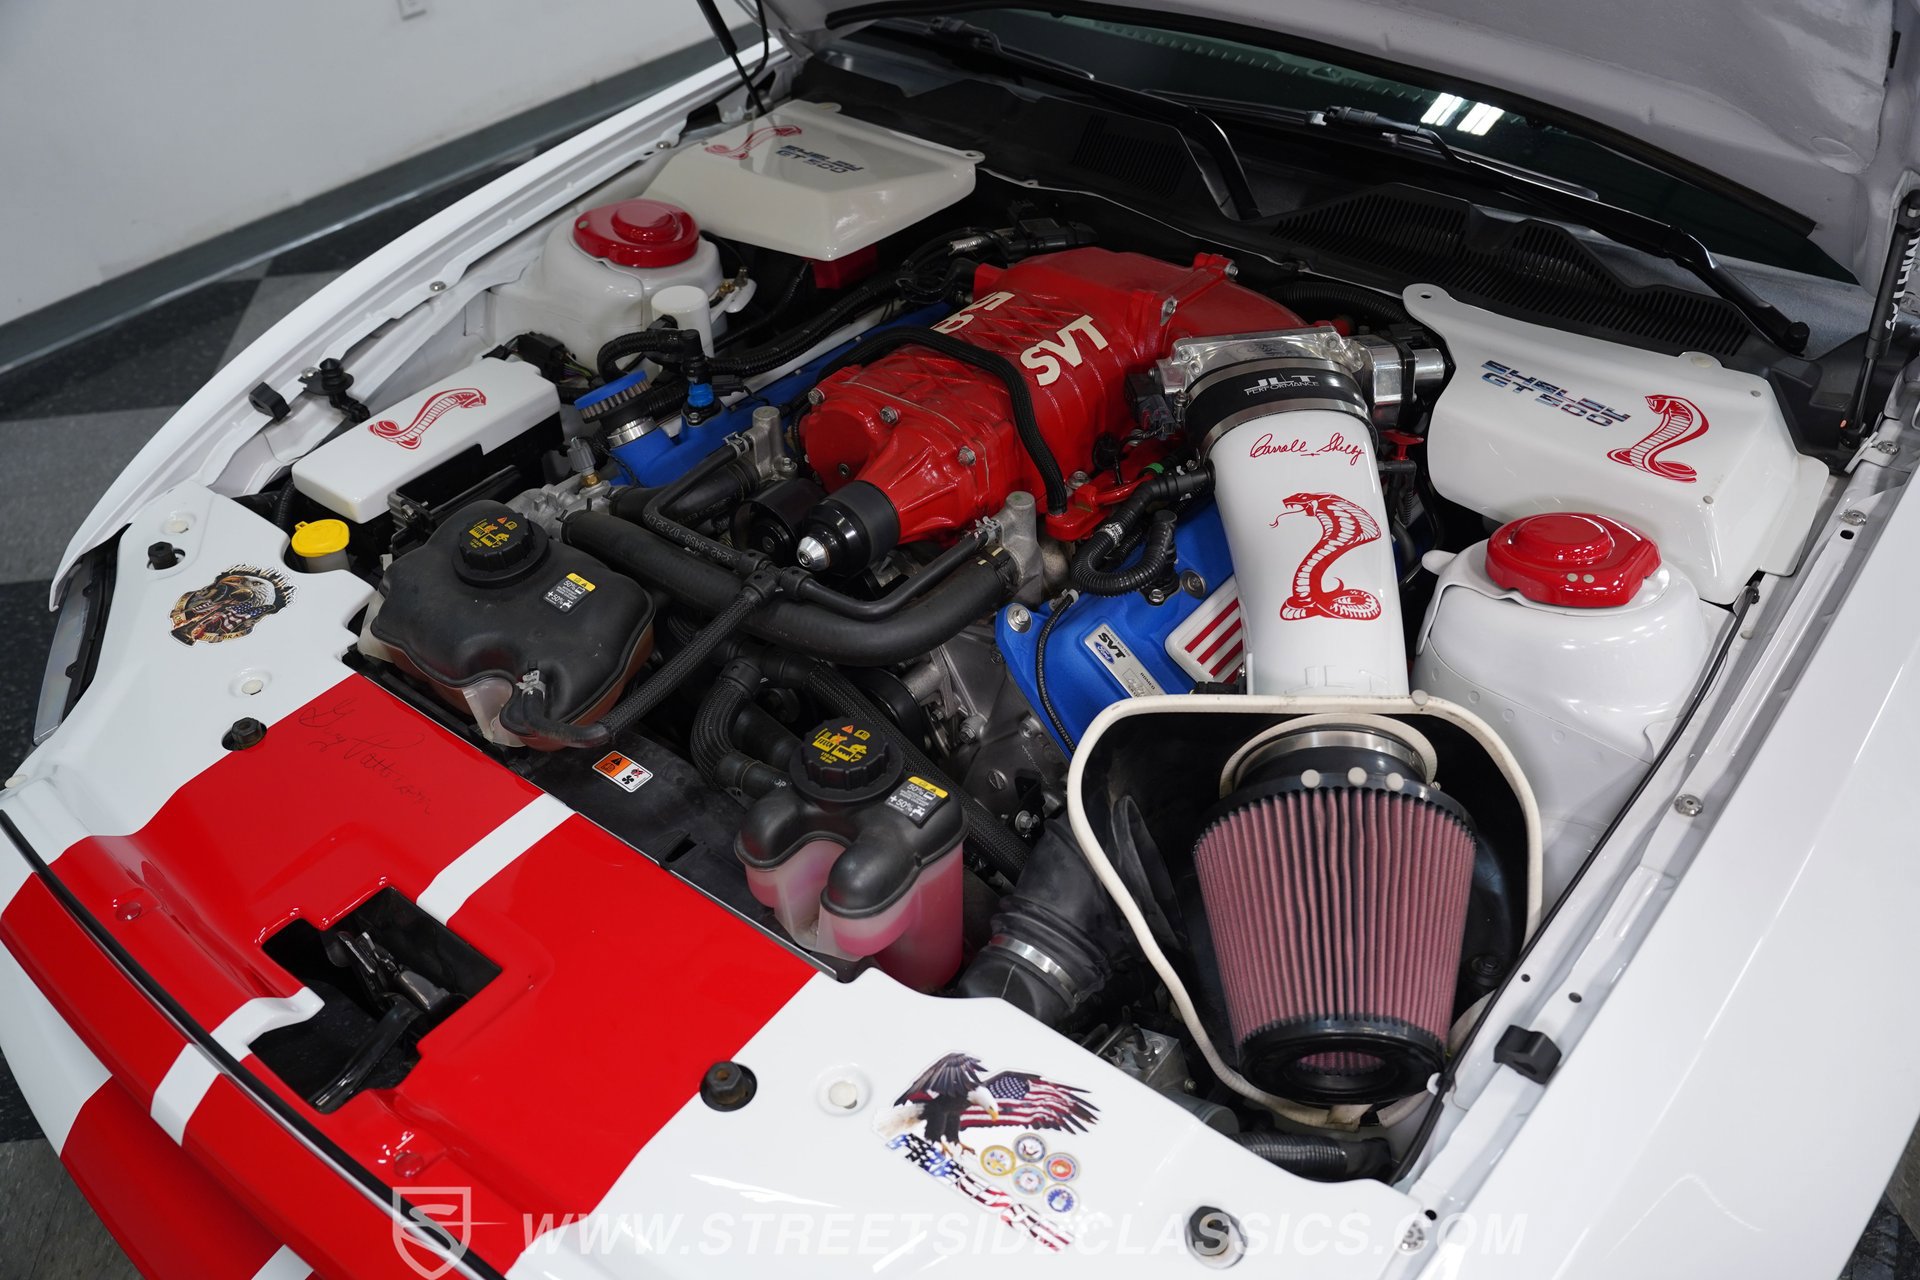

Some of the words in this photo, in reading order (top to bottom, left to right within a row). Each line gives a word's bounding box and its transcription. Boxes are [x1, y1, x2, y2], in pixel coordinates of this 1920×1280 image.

[1020, 314, 1108, 386] SVT
[1244, 373, 1316, 391] JLT
[1246, 381, 1320, 396] PERFORMANCE
[1481, 360, 1631, 423] SHELBY
[1098, 632, 1126, 658] SVT
